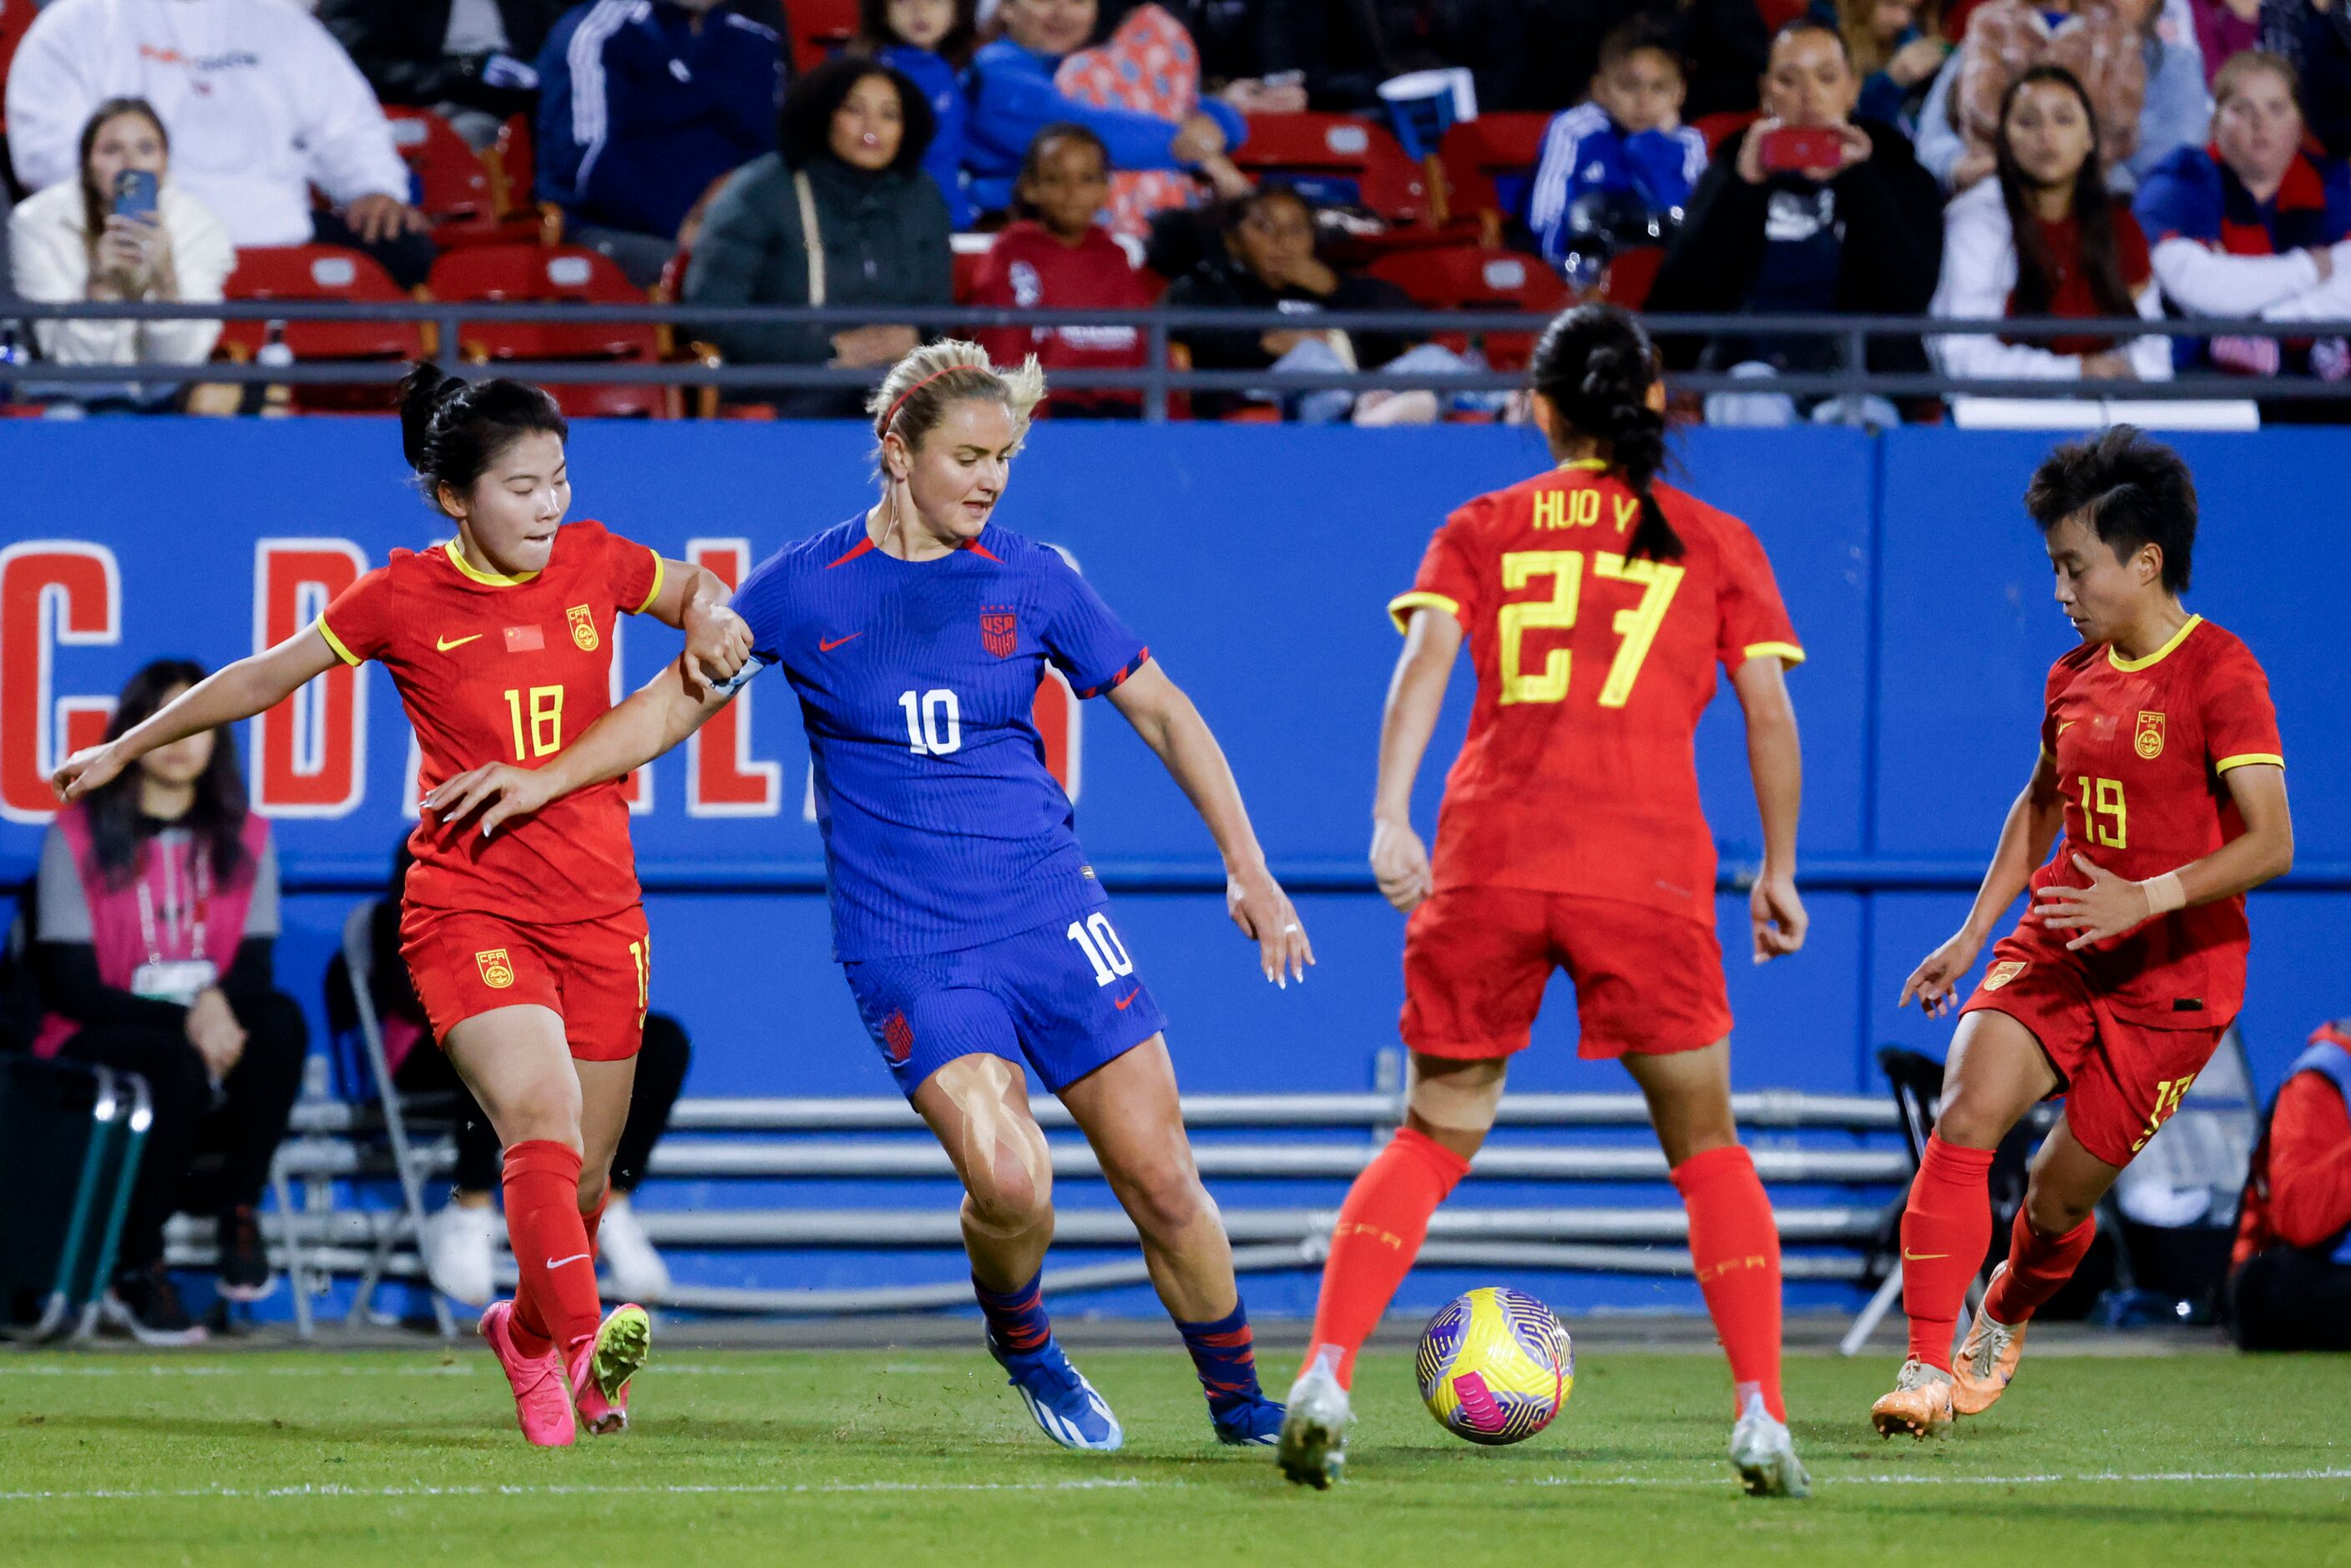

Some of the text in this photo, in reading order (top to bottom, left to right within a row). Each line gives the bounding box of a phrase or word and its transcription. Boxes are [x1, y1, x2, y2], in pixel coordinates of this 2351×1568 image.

[1533, 489, 1600, 530] HUO
[569, 608, 589, 620] CFA
[982, 616, 1014, 635] USA
[1498, 550, 1686, 708] 27
[504, 685, 564, 761] 18
[898, 689, 961, 756] 10
[2140, 714, 2163, 724] CFA
[2078, 776, 2127, 849] 19
[479, 952, 505, 963] CFA
[1067, 912, 1133, 987] 10
